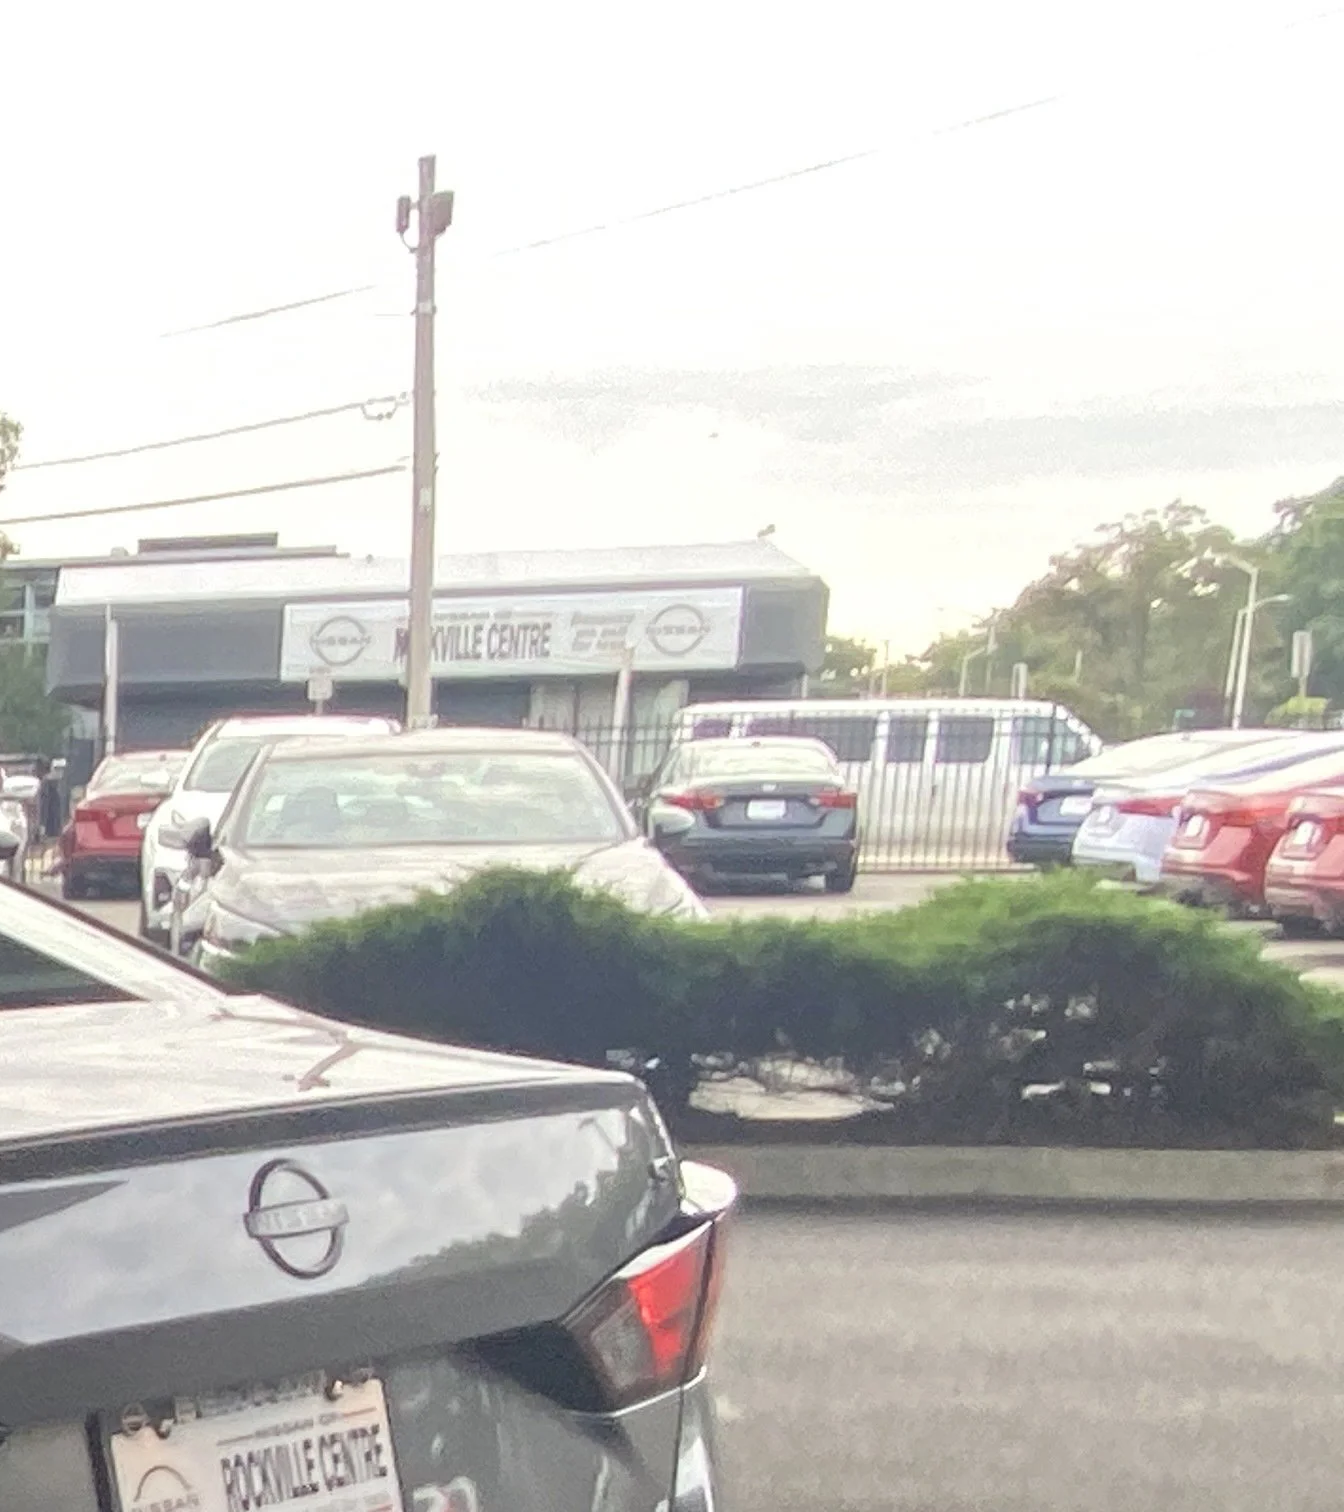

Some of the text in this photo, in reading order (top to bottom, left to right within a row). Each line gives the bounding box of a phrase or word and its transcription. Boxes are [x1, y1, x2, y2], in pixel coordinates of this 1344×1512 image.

[393, 622, 483, 664] RKVILLE
[487, 621, 553, 660] CENTRE
[318, 1423, 388, 1492] CENTRE
